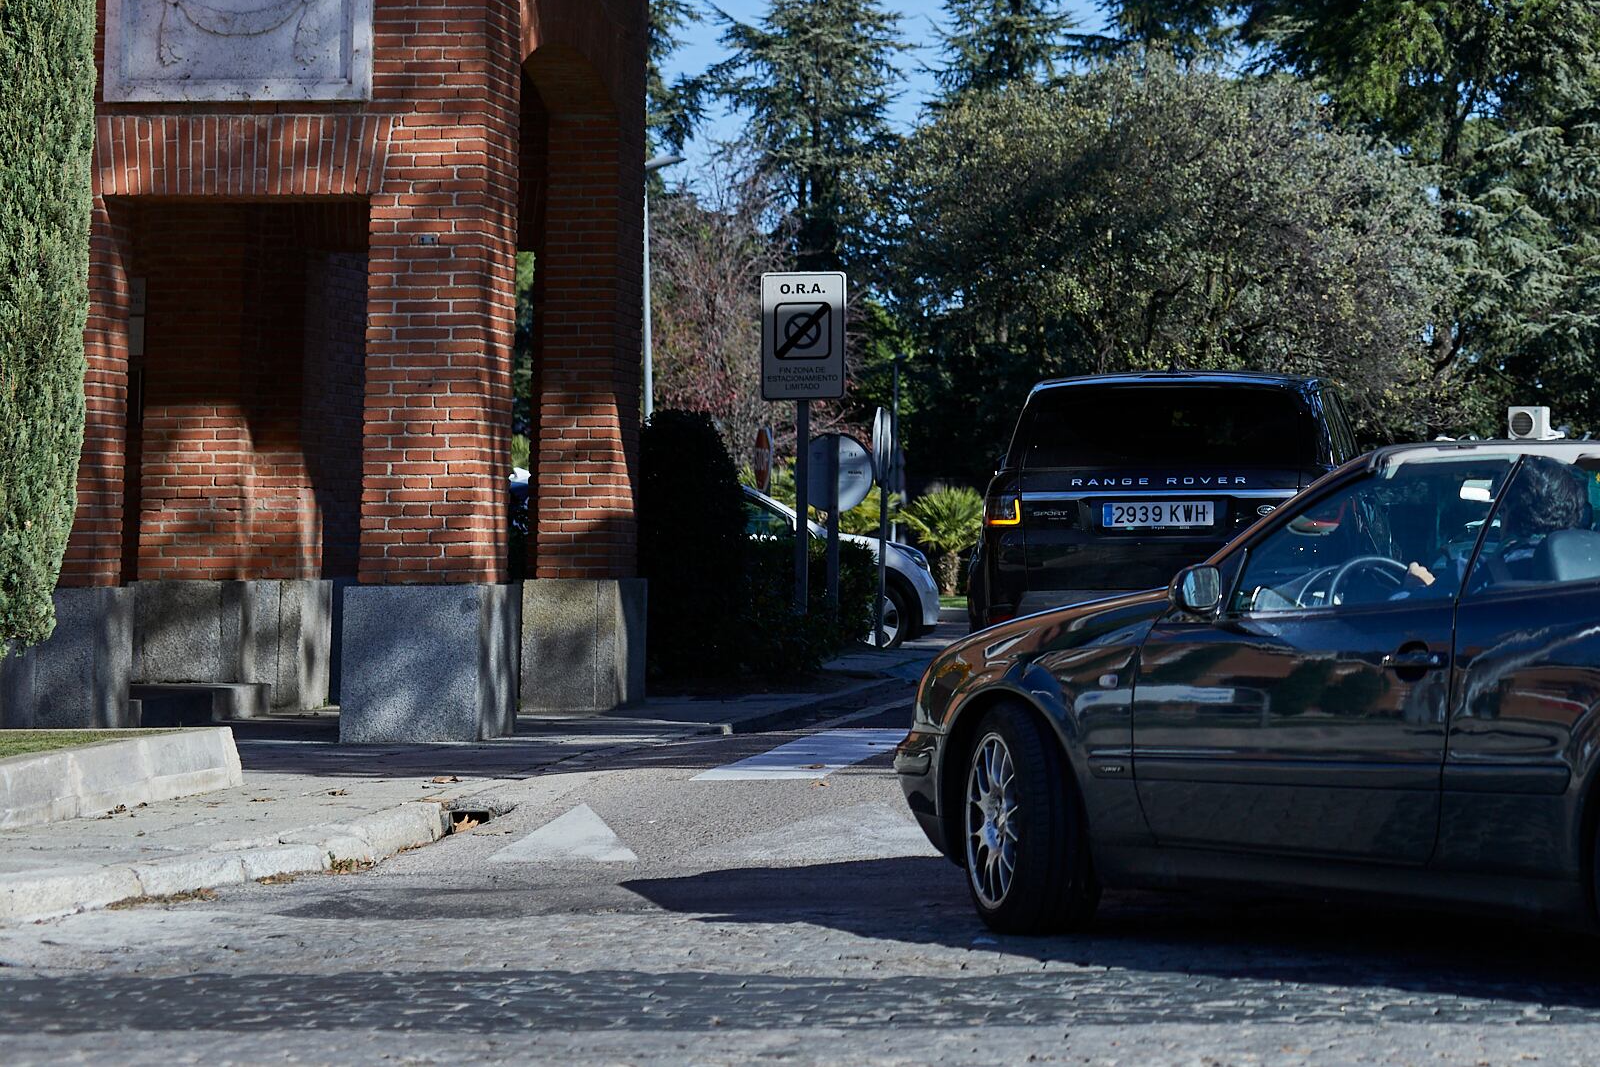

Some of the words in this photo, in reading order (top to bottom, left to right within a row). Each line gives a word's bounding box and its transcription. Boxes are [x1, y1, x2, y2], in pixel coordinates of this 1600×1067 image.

[780, 283, 826, 294] O.R.A.
[767, 374, 839, 383] ESTACIONAMIENTO
[785, 383, 820, 391] LIMITADO
[1071, 477, 1149, 486] RANGE
[1166, 476, 1247, 485] ROVER
[1114, 505, 1163, 524] 2939
[1169, 504, 1206, 522] KWH
